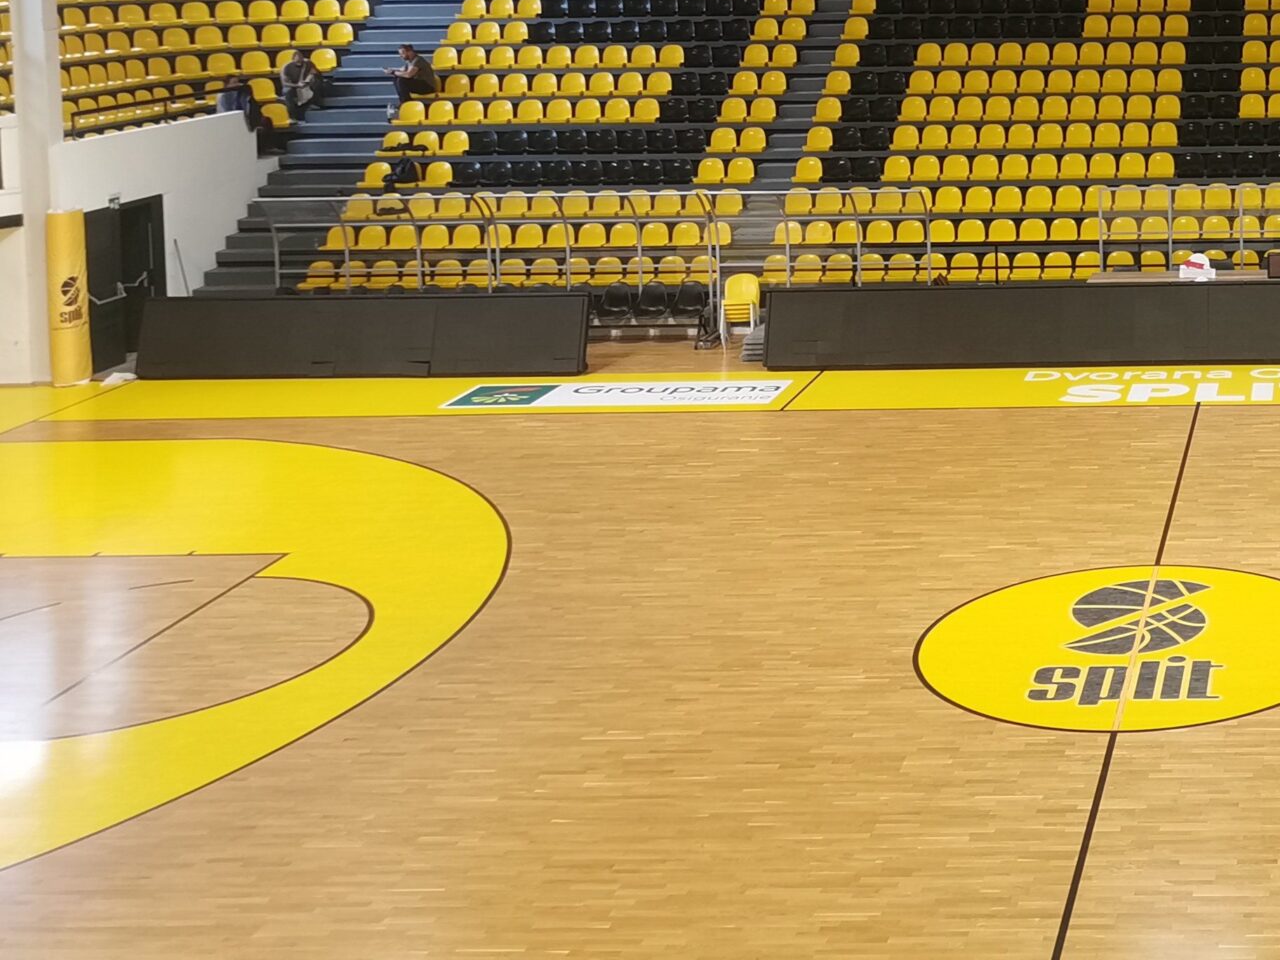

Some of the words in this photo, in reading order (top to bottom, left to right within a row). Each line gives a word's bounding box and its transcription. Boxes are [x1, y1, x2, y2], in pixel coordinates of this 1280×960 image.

[1023, 368, 1232, 382] Dvorana
[572, 384, 781, 395] Groupama
[1027, 656, 1223, 705] split
